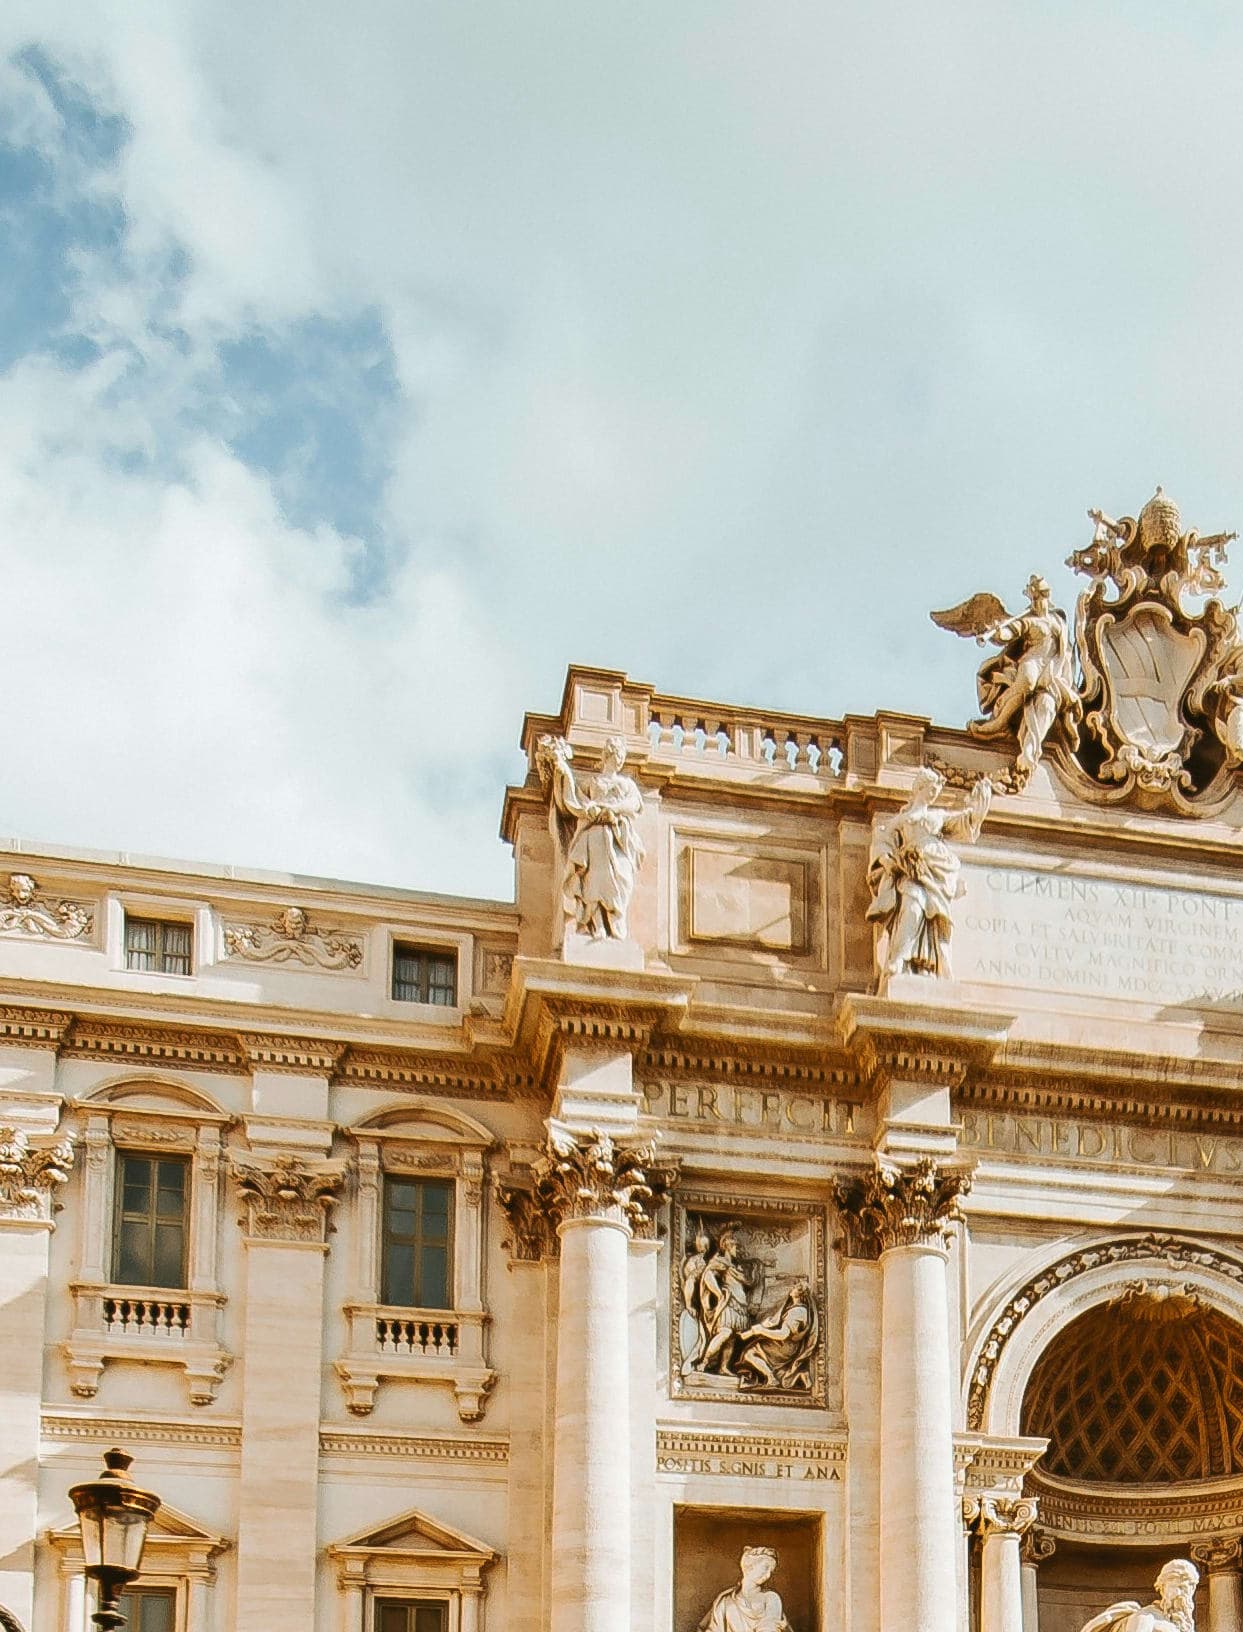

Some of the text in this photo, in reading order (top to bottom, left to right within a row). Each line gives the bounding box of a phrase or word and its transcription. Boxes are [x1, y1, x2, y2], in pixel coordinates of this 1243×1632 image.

[985, 871, 1100, 902] CLEMENS
[1064, 907, 1240, 943] AQVAM VIRGINEM
[974, 959, 1032, 977] ANNO
[641, 1080, 863, 1135] PERFECIT
[956, 1112, 1243, 1172] BENEDICTVS
[656, 1456, 712, 1474] POSITIS
[776, 1464, 794, 1479] ET
[803, 1465, 841, 1481] ANA
